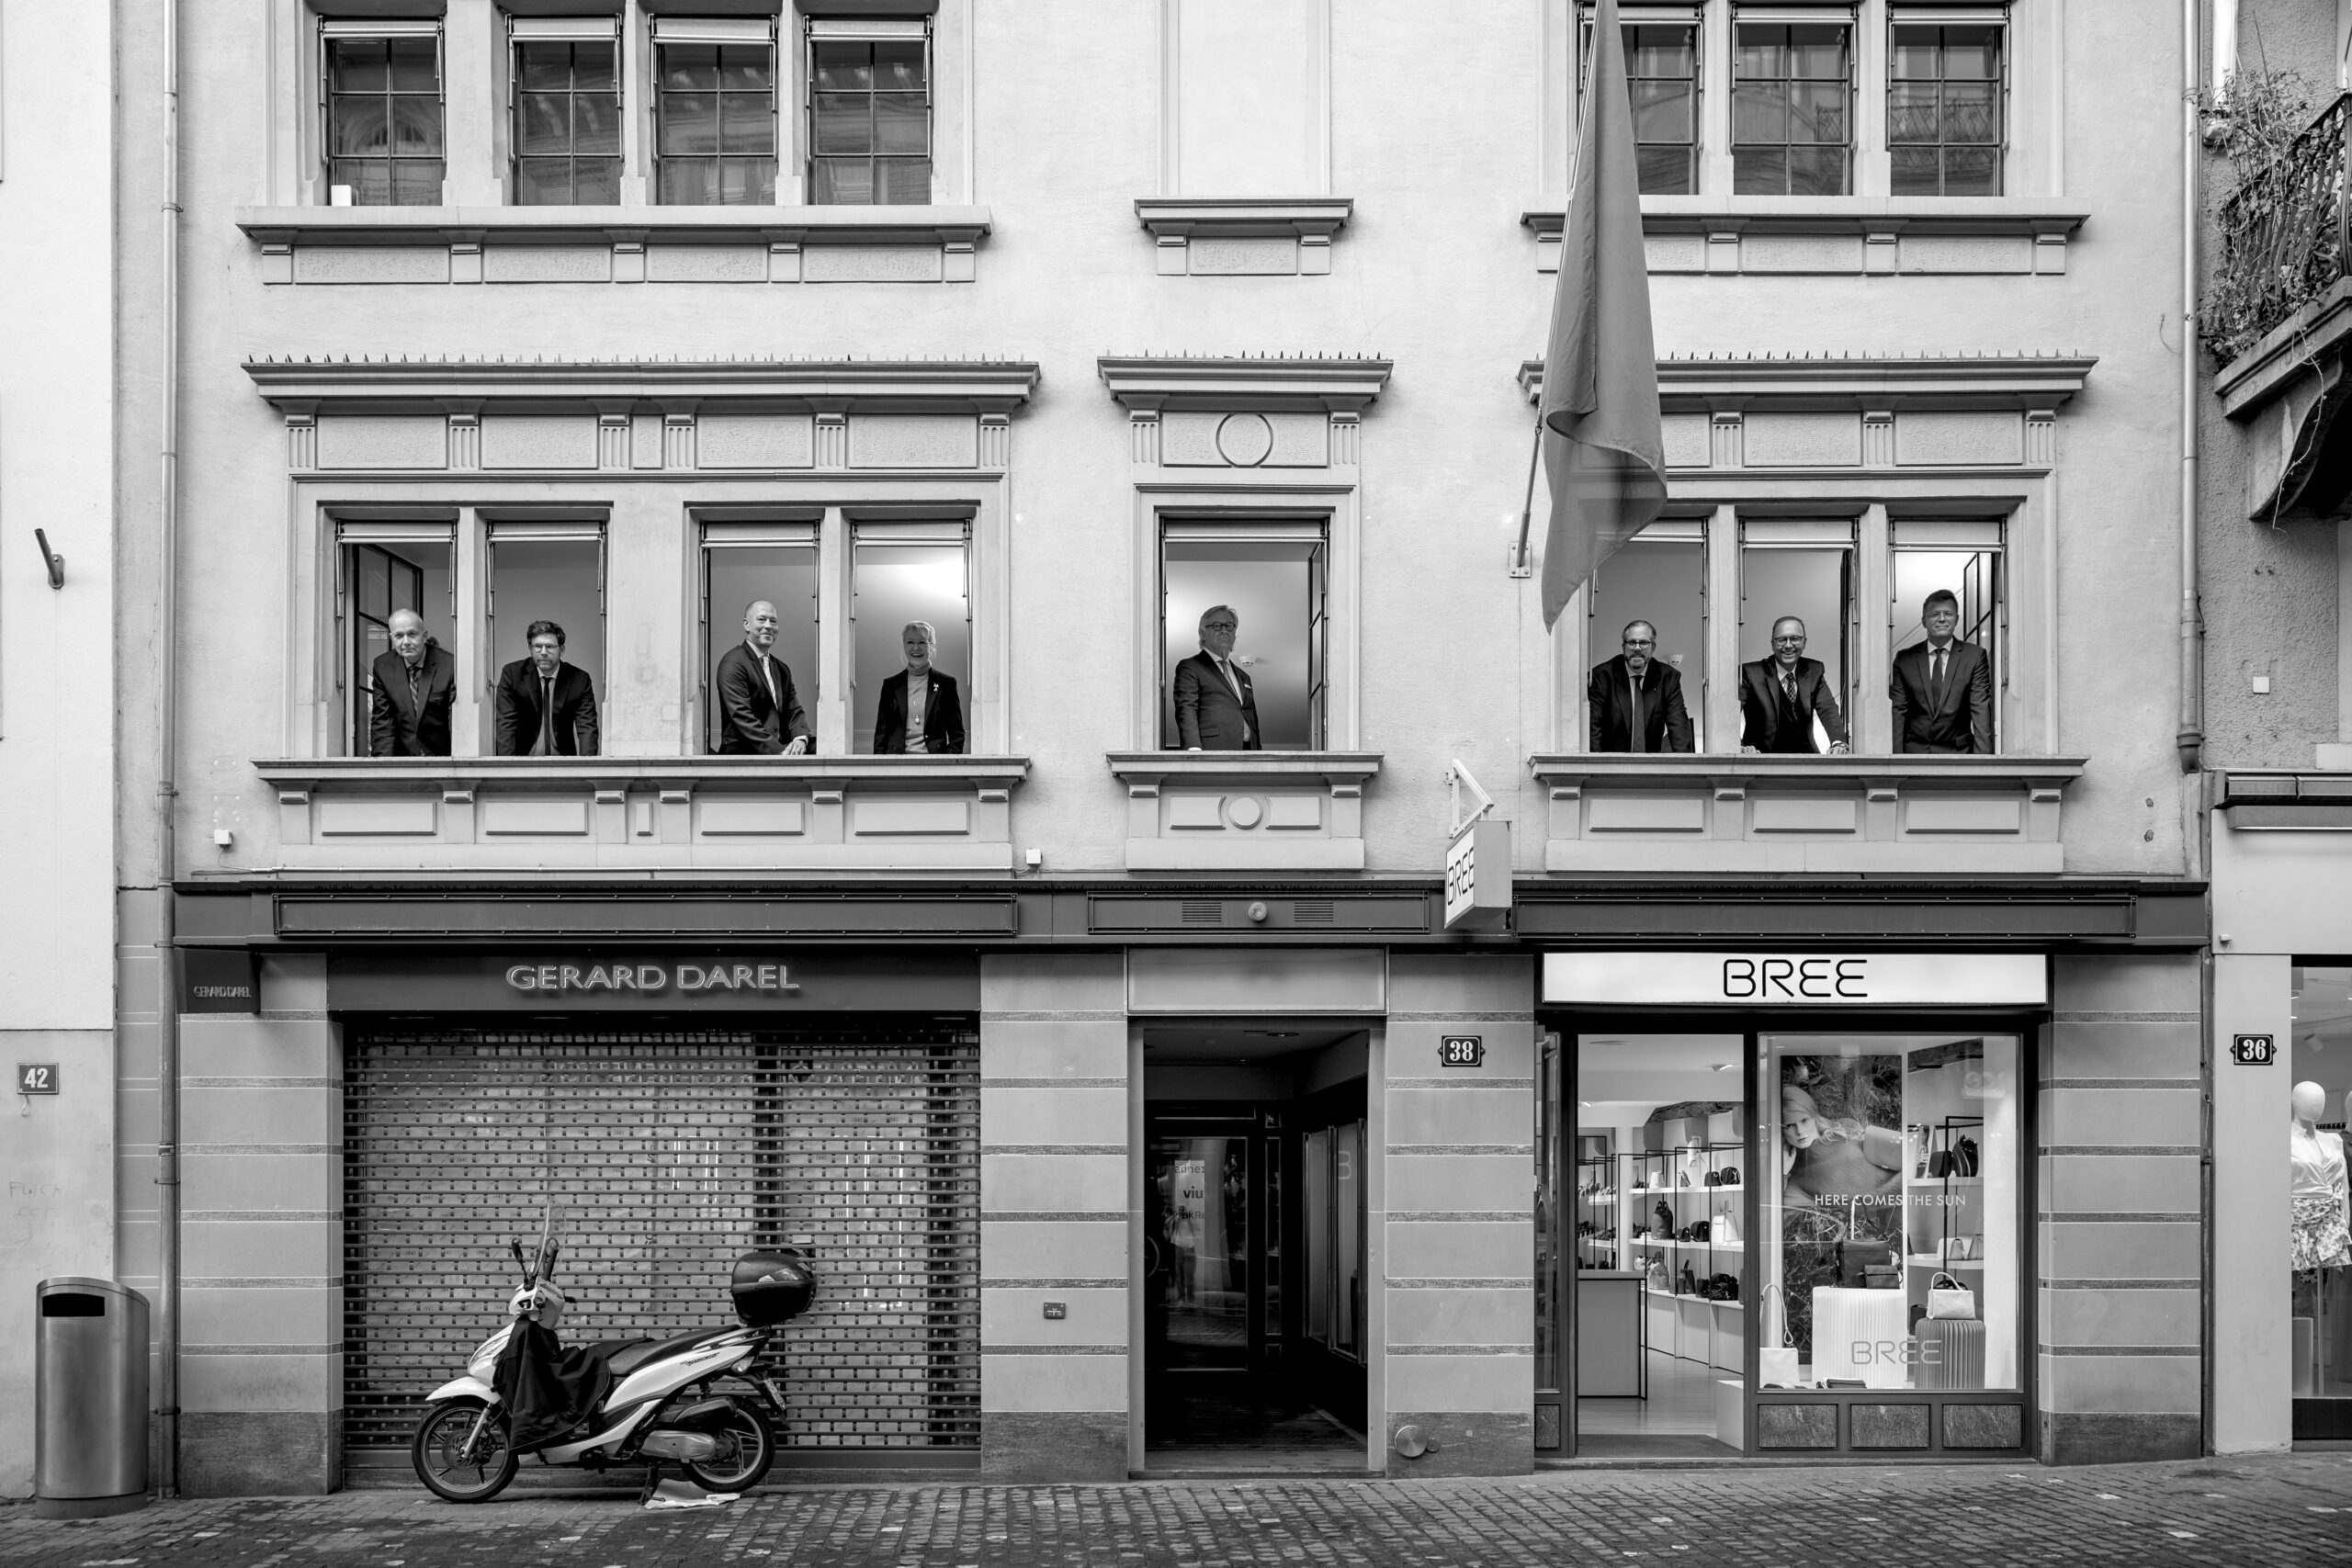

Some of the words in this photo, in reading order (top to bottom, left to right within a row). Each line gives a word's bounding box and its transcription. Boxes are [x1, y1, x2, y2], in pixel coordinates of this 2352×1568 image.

[1447, 846, 1474, 907] BREE
[504, 964, 666, 990] GERARD
[676, 964, 799, 990] DAREL
[1724, 959, 1868, 998] BREE
[193, 986, 227, 998] GERARD
[227, 986, 252, 998] DAREL
[1449, 1041, 1474, 1061] 38
[2243, 1039, 2267, 1060] 36
[24, 1067, 49, 1089] 42
[1815, 1194, 1848, 1206] HERE
[1853, 1194, 1903, 1206] COMES
[1908, 1194, 1931, 1206] THE
[1937, 1194, 1966, 1206] SUN
[1851, 1340, 1942, 1364] BREE
